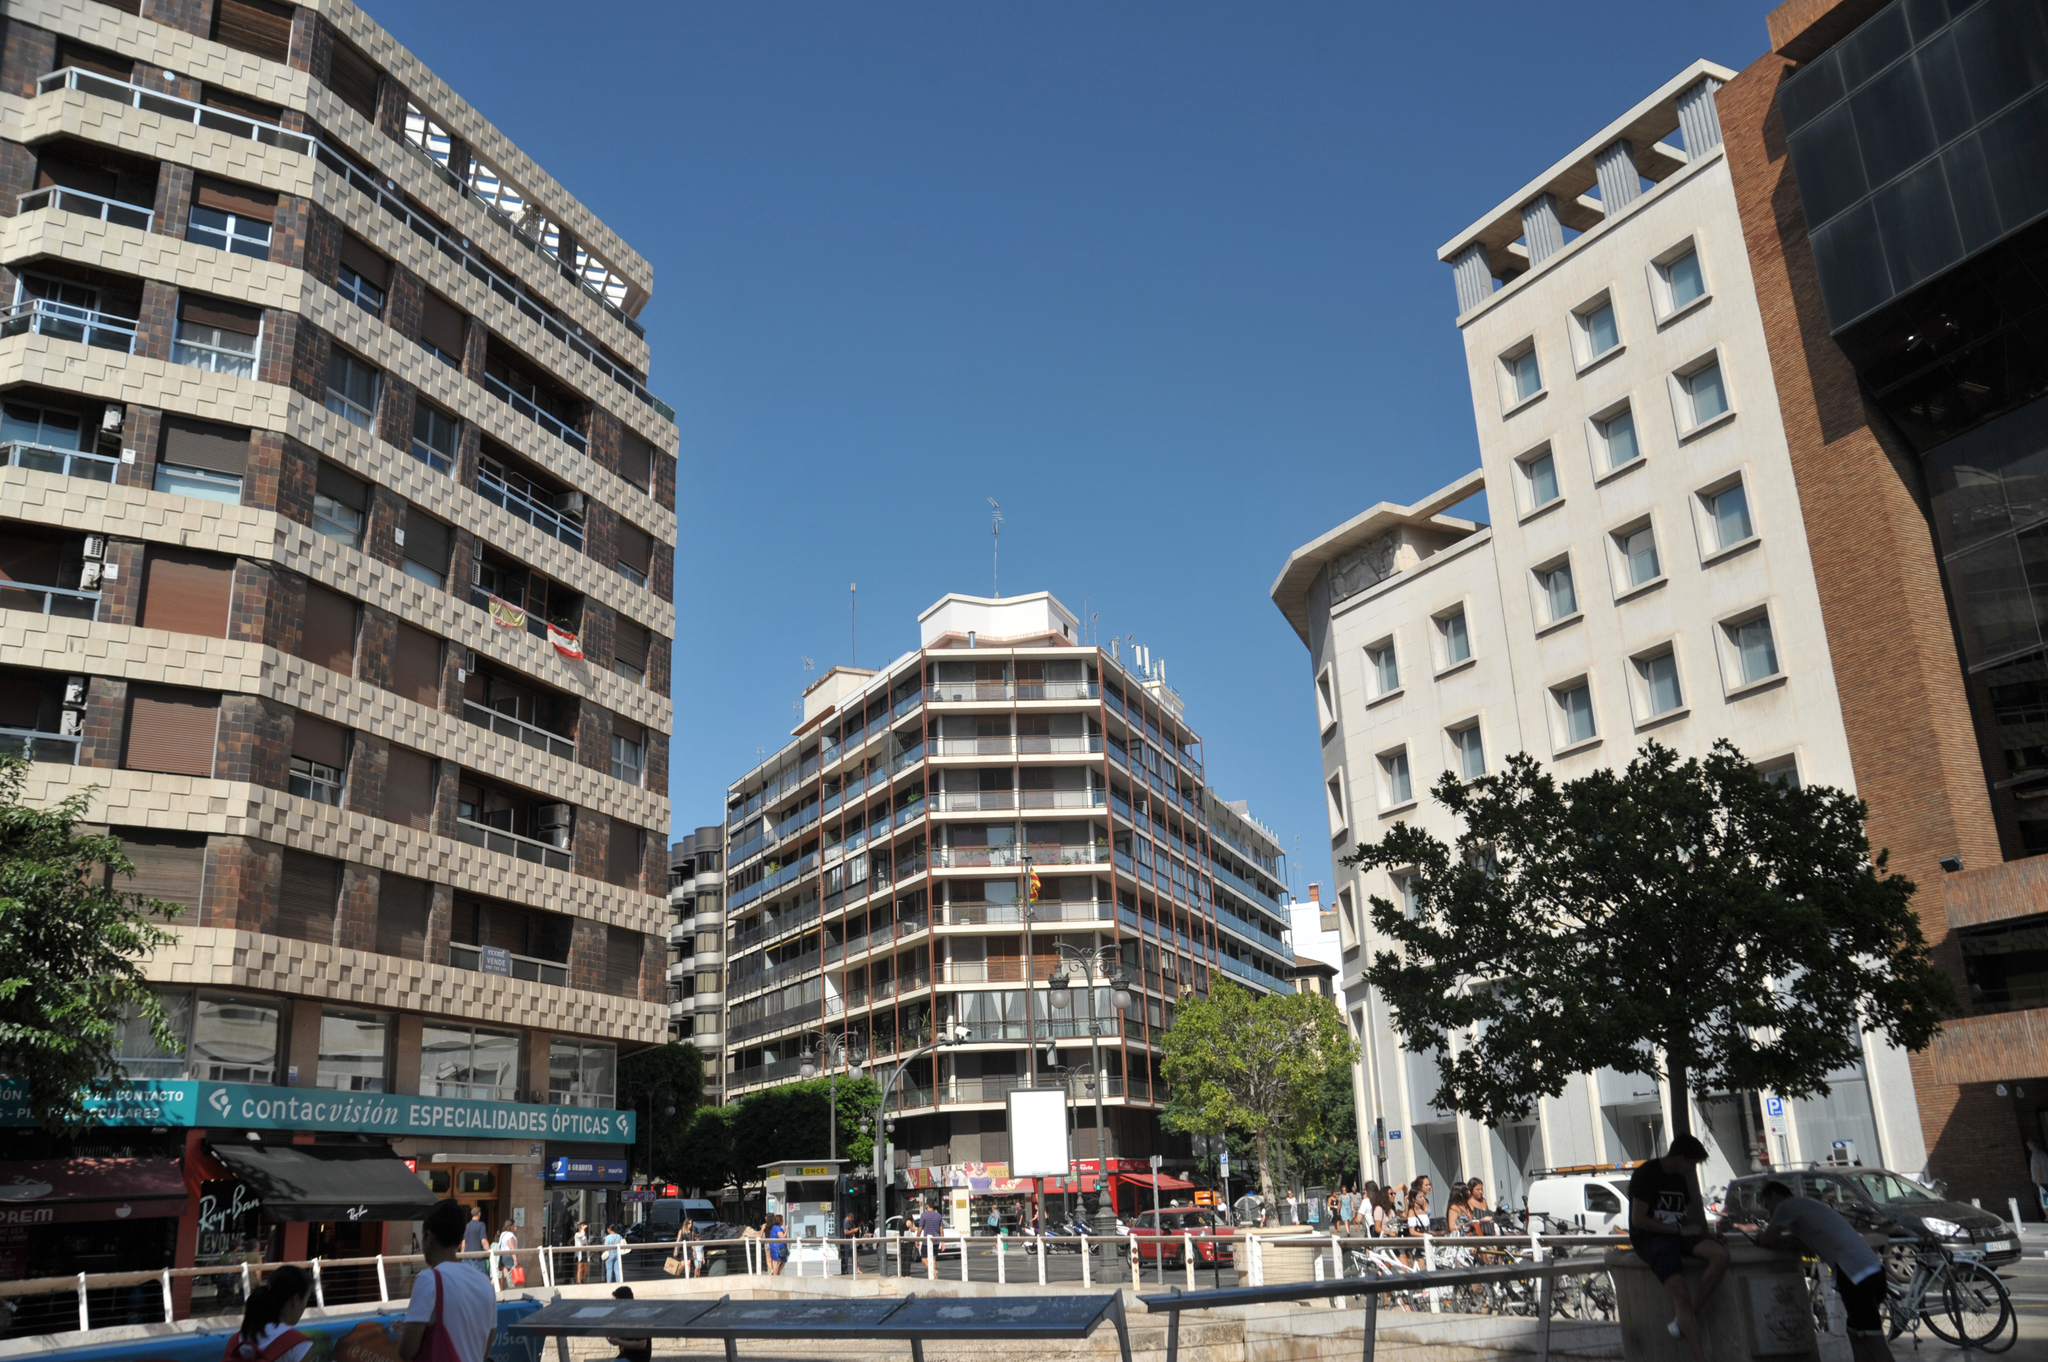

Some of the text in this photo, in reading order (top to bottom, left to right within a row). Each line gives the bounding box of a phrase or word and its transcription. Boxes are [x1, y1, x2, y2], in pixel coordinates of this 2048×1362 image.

[487, 957, 506, 966] VENDE
[116, 1090, 184, 1101] CONTACTO
[1768, 1098, 1780, 1115] P
[241, 1097, 610, 1134] contacvisión ESPECIALIDADES ÓPTICAS
[805, 1167, 825, 1175] ONCE
